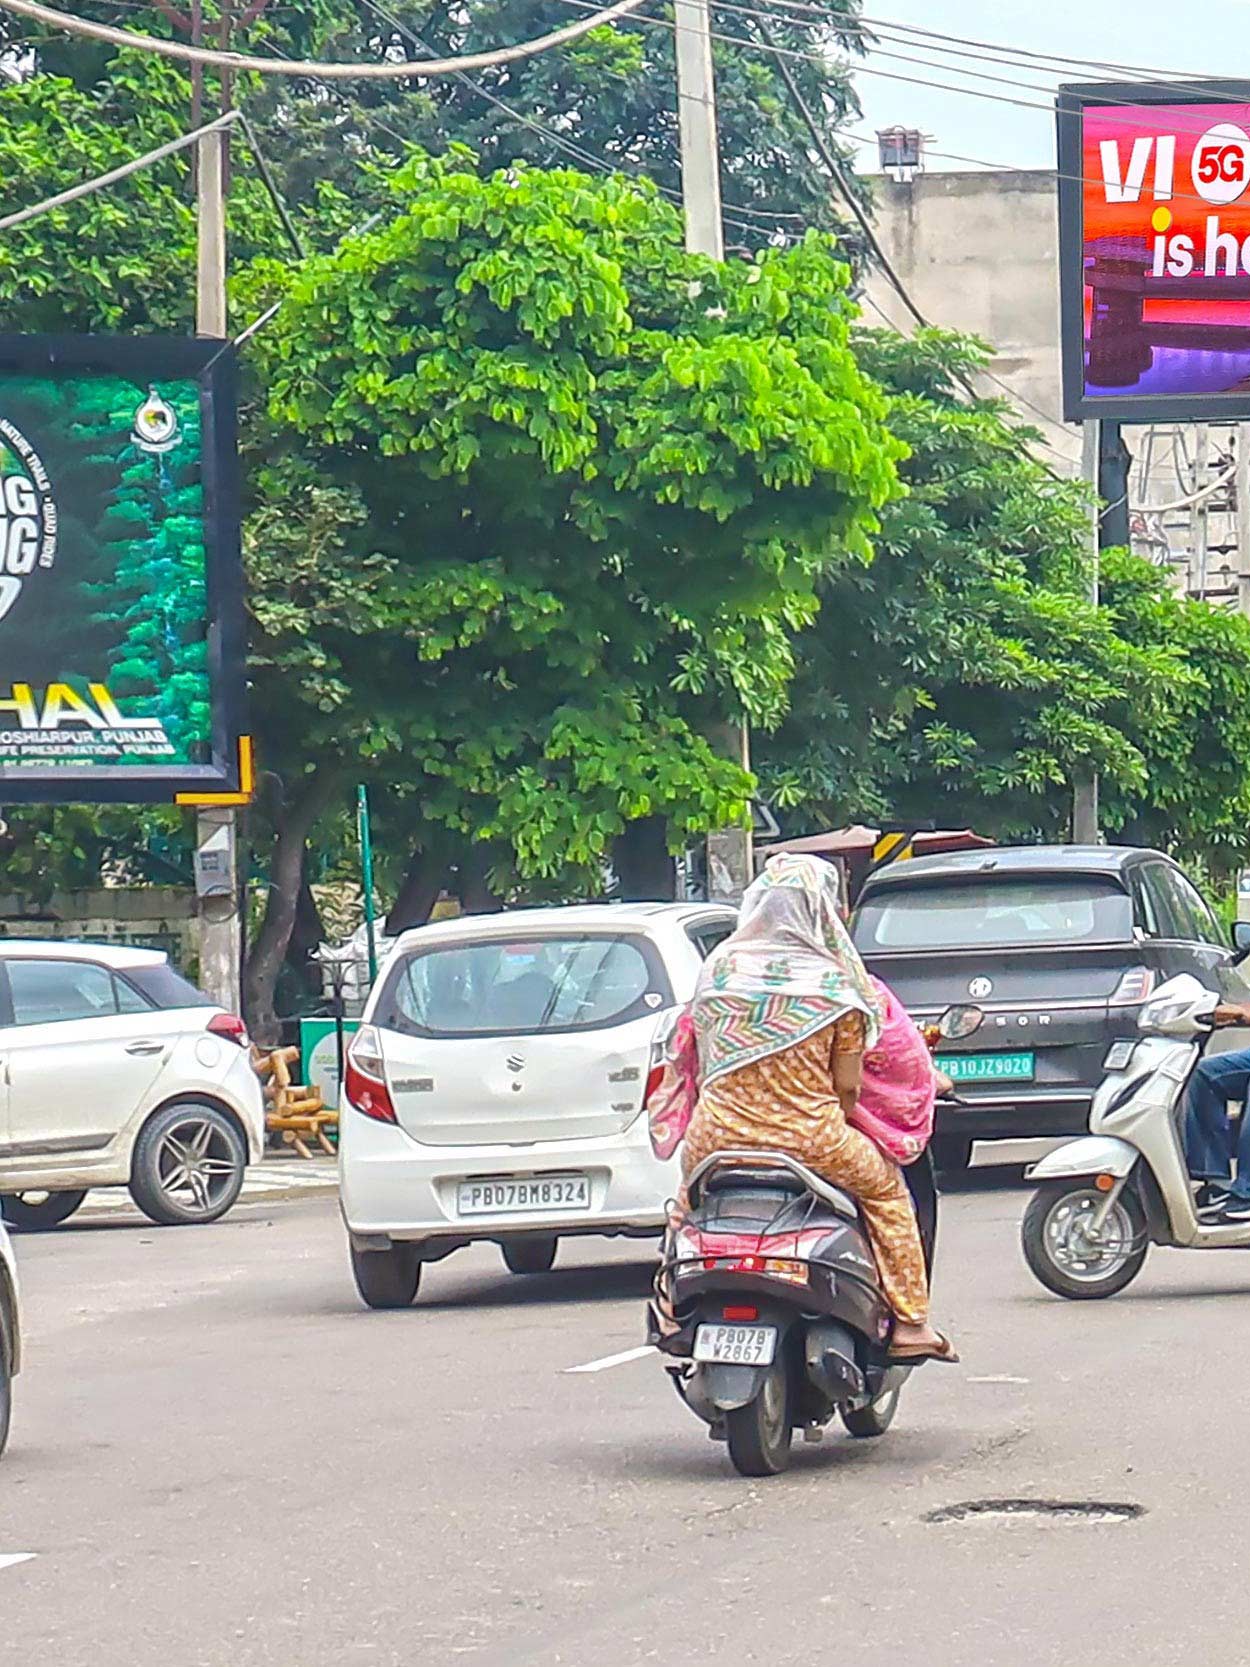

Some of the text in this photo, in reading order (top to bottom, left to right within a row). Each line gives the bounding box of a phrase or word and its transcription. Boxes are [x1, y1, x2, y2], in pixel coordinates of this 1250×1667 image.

[1198, 144, 1245, 184] 5G
[1152, 206, 1195, 278] is
[26, 452, 51, 492] TRAILS
[0, 475, 39, 516] G
[0, 516, 39, 575] G
[102, 731, 168, 743] PUNJAB
[471, 1182, 586, 1207] PB07BM8324
